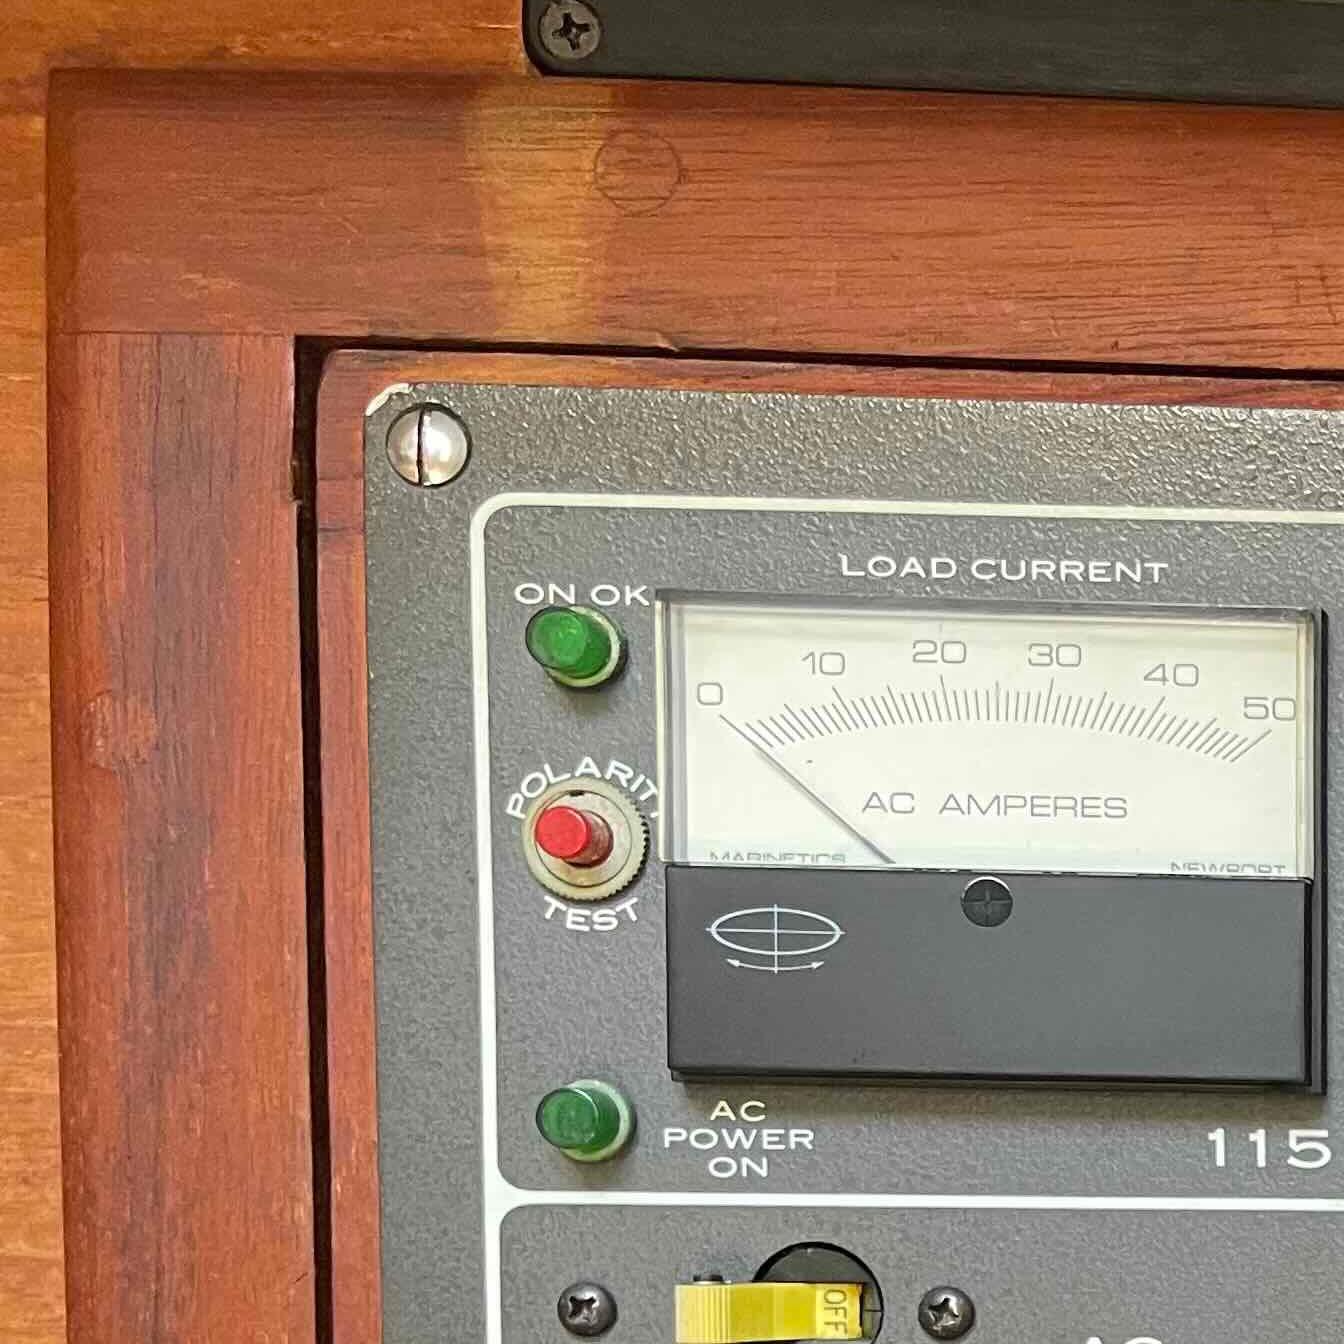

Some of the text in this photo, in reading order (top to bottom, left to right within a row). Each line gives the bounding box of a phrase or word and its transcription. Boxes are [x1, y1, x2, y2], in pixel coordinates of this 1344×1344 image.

[839, 555, 1169, 584] LOAD CURRENT
[513, 582, 650, 607] ON OK
[697, 639, 1298, 722] 0 10 20 30 40 50
[505, 756, 661, 821] POLARIT
[861, 792, 1129, 821] AC AMPERES
[542, 898, 638, 932] TEST
[710, 1100, 766, 1122] AC
[663, 1128, 815, 1151] POWER
[1209, 1128, 1331, 1169] 115
[708, 1157, 769, 1179] ON
[823, 1288, 847, 1336] OFF
